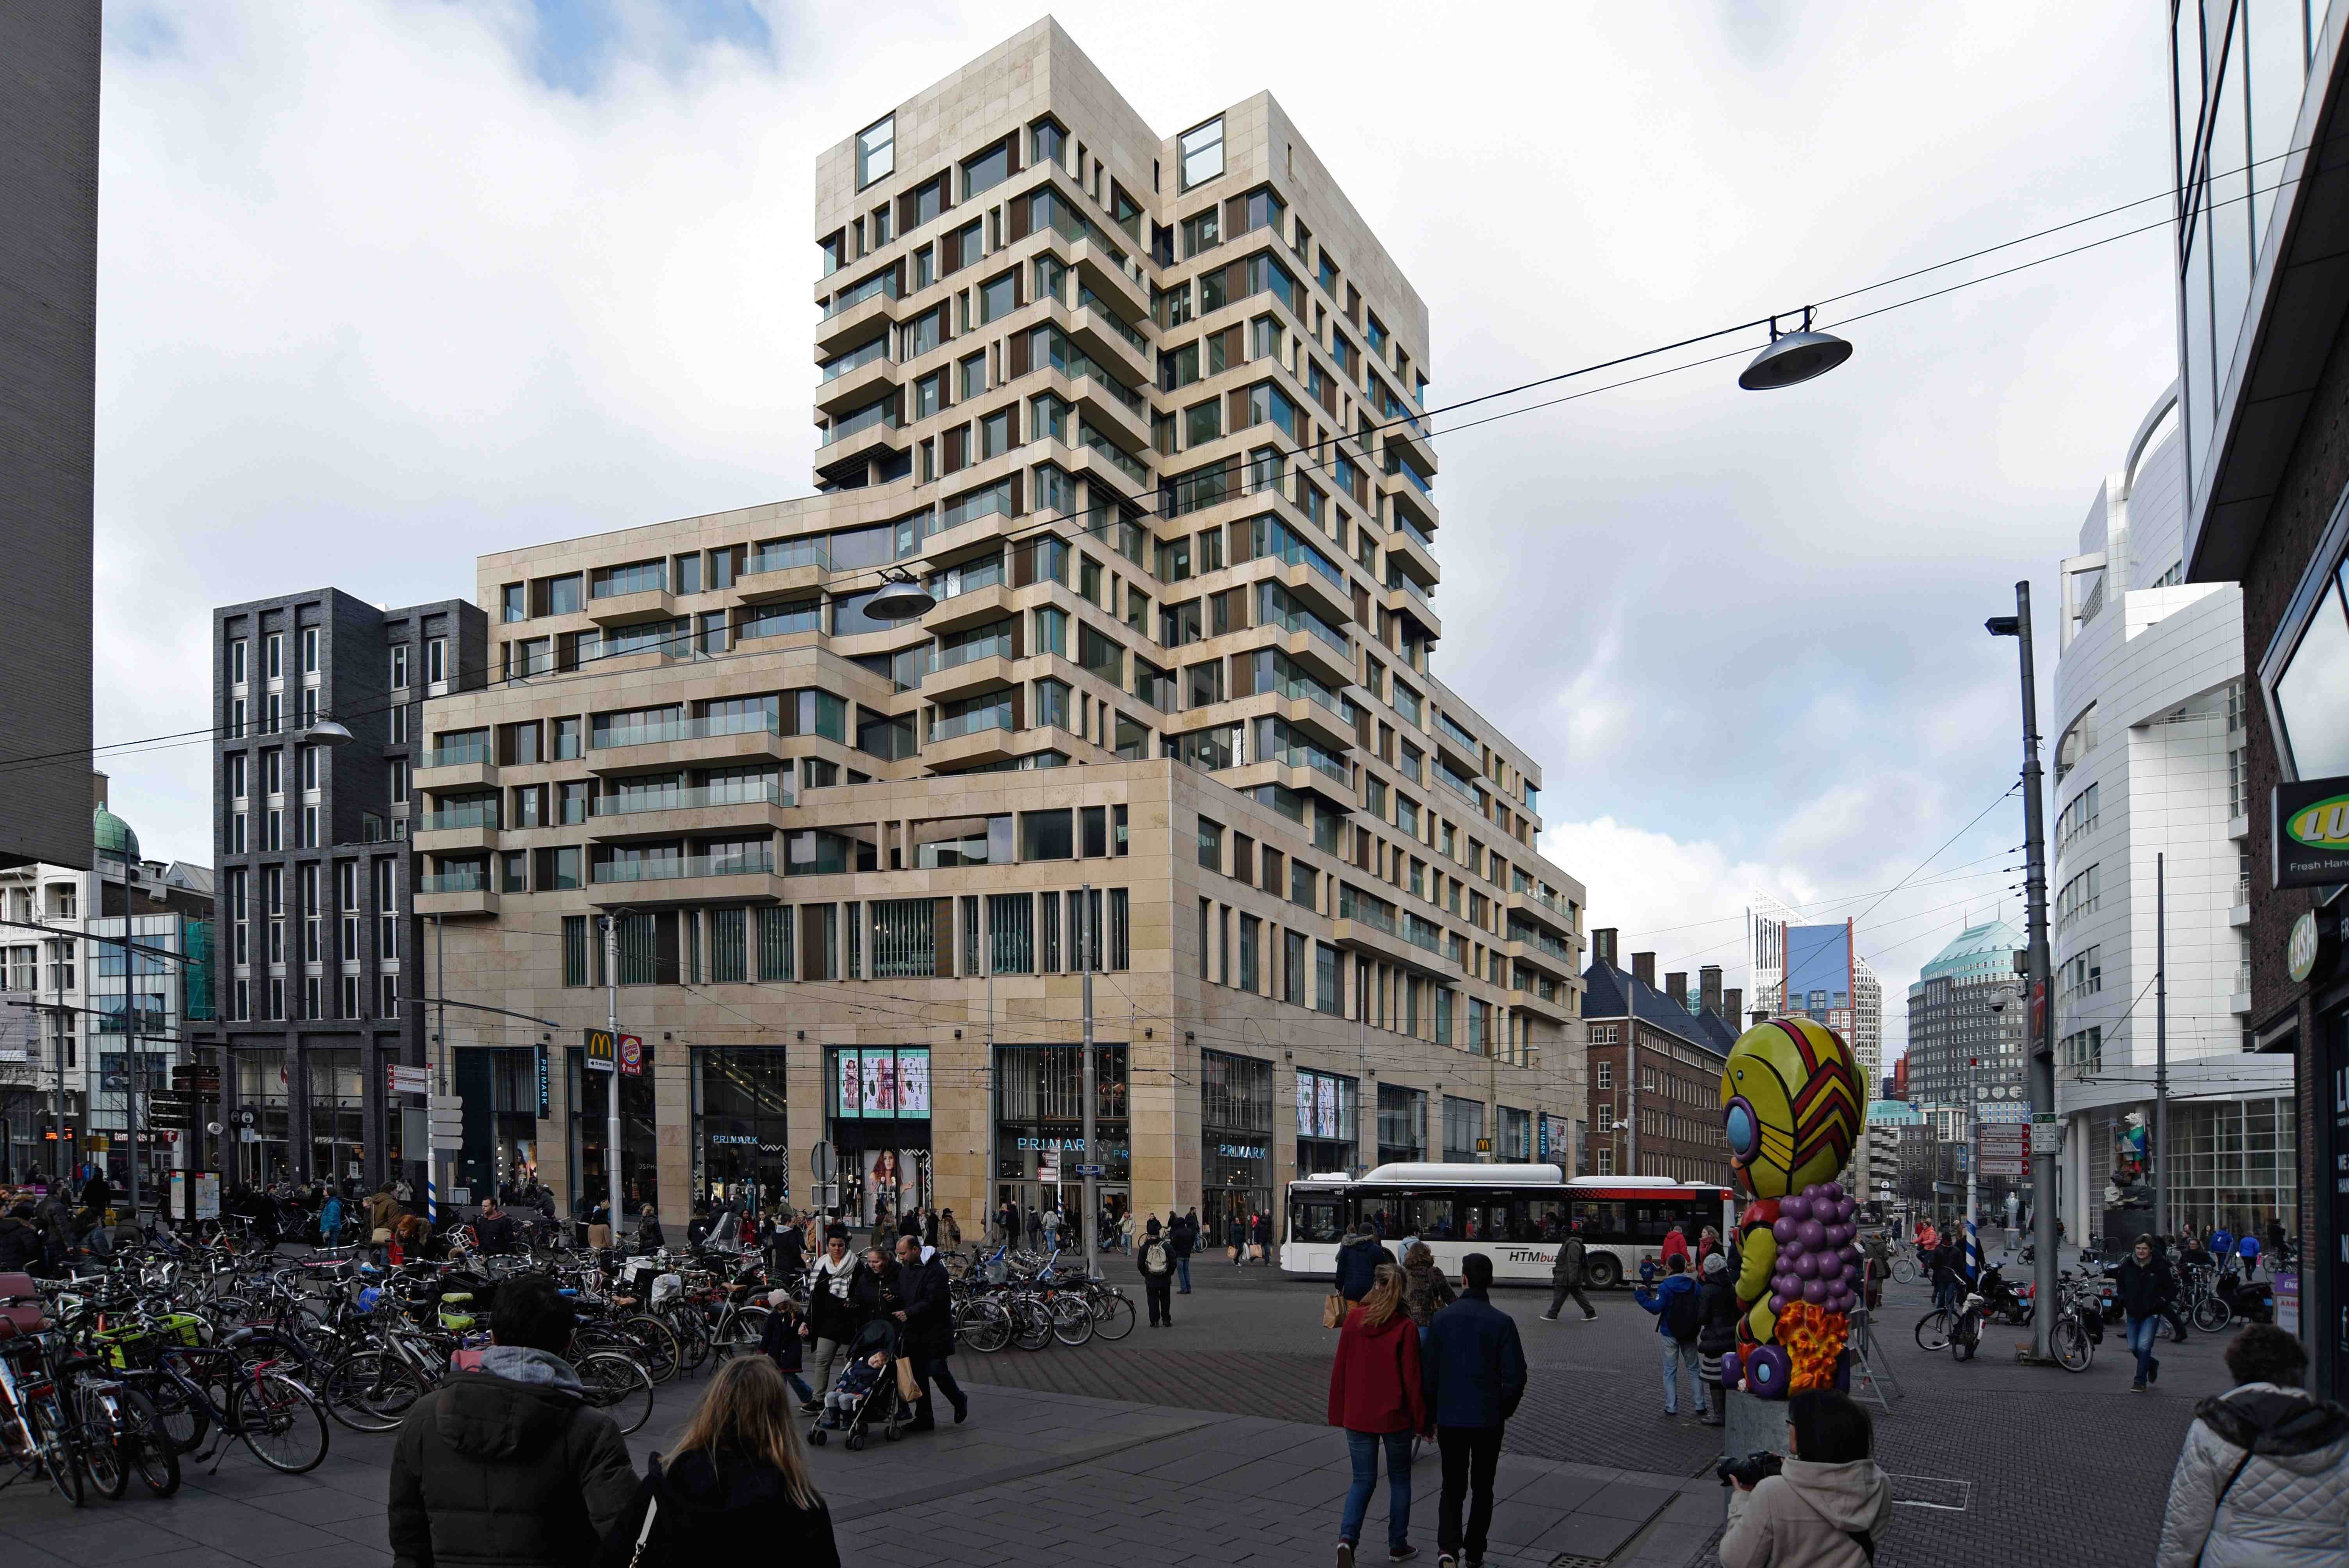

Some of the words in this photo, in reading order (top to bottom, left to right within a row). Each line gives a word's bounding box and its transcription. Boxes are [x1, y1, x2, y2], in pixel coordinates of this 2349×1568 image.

[2290, 861, 2320, 871] Fresh
[2290, 916, 2315, 974] LUSH
[625, 1049, 638, 1057] KING
[713, 1135, 758, 1144] PRIMARK
[1018, 1138, 1098, 1151] PRIMAR
[1220, 1144, 1265, 1159] PRIMARK
